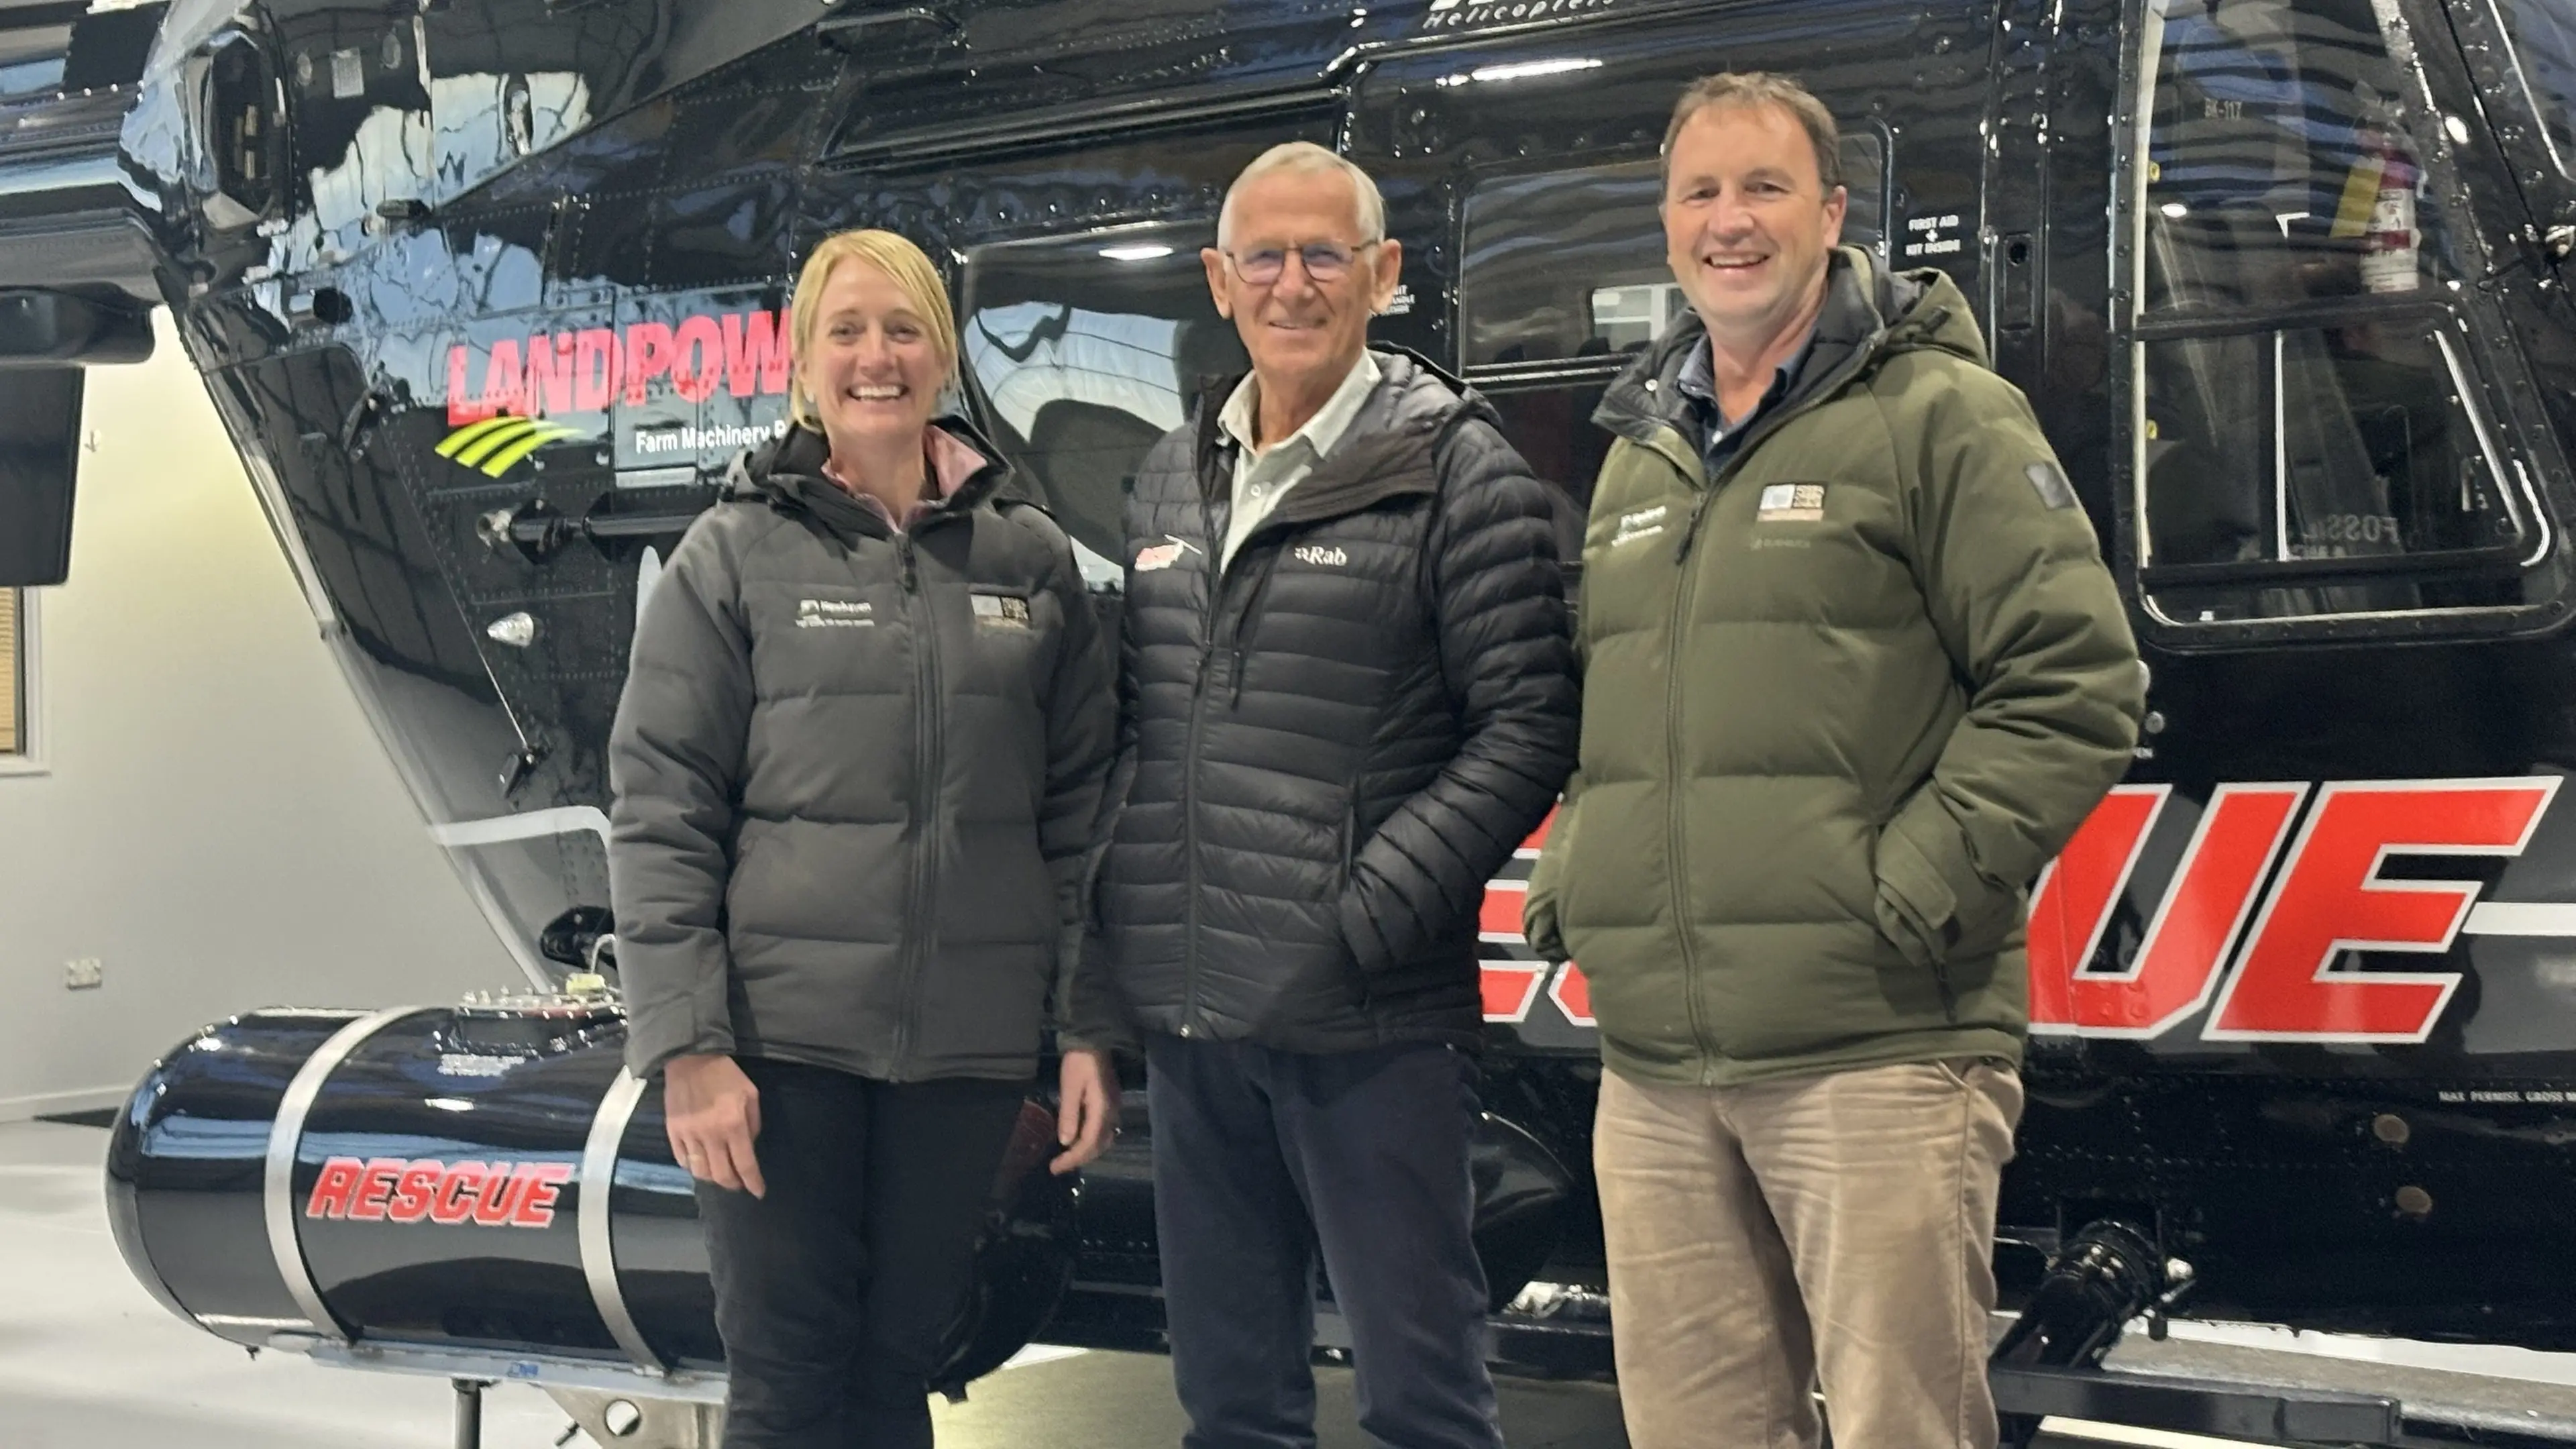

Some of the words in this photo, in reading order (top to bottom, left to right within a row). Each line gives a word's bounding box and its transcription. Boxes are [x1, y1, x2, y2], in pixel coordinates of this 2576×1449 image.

[1423, 0, 1611, 29] Helicopte
[635, 429, 678, 454] Farm
[681, 423, 771, 449] Machinery
[1309, 545, 1348, 567] Rab
[306, 1156, 576, 1228] RESCUE
